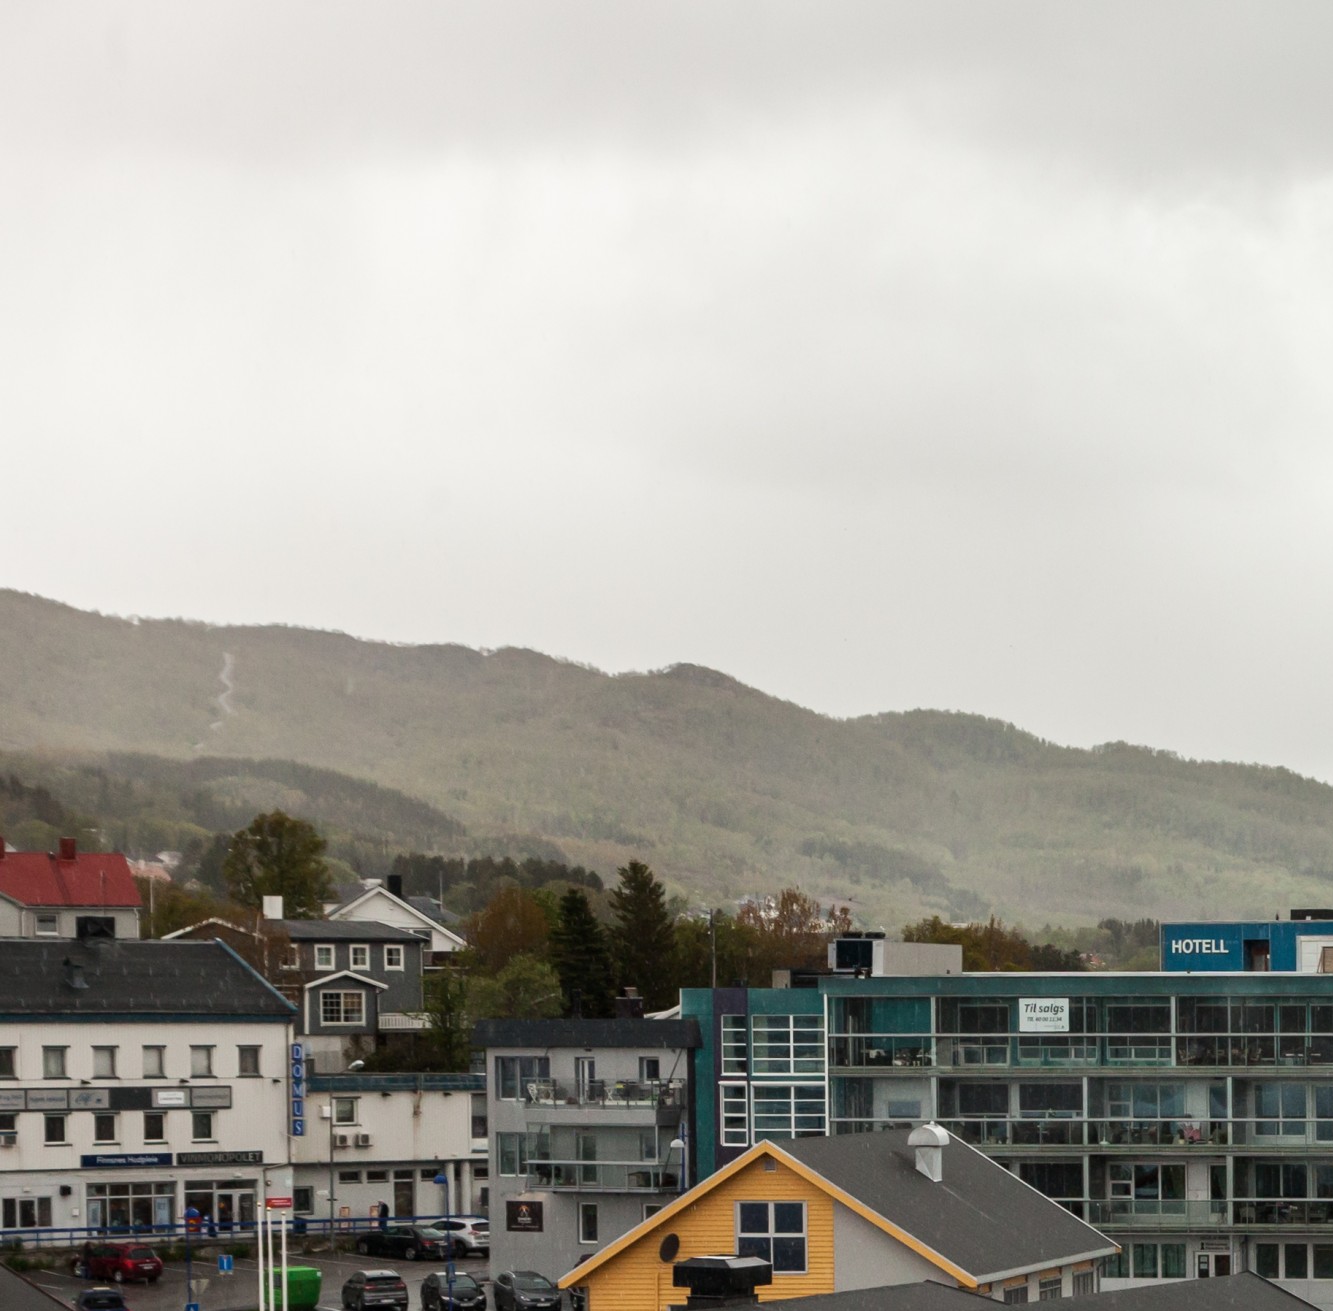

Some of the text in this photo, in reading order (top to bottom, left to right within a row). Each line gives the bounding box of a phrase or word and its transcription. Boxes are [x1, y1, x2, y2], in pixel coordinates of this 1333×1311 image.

[1171, 939, 1229, 953] HOTELL
[1024, 1003, 1065, 1015] Til salgs
[292, 1045, 303, 1134] DOMUS
[180, 1152, 261, 1163] VINMONOPOLET
